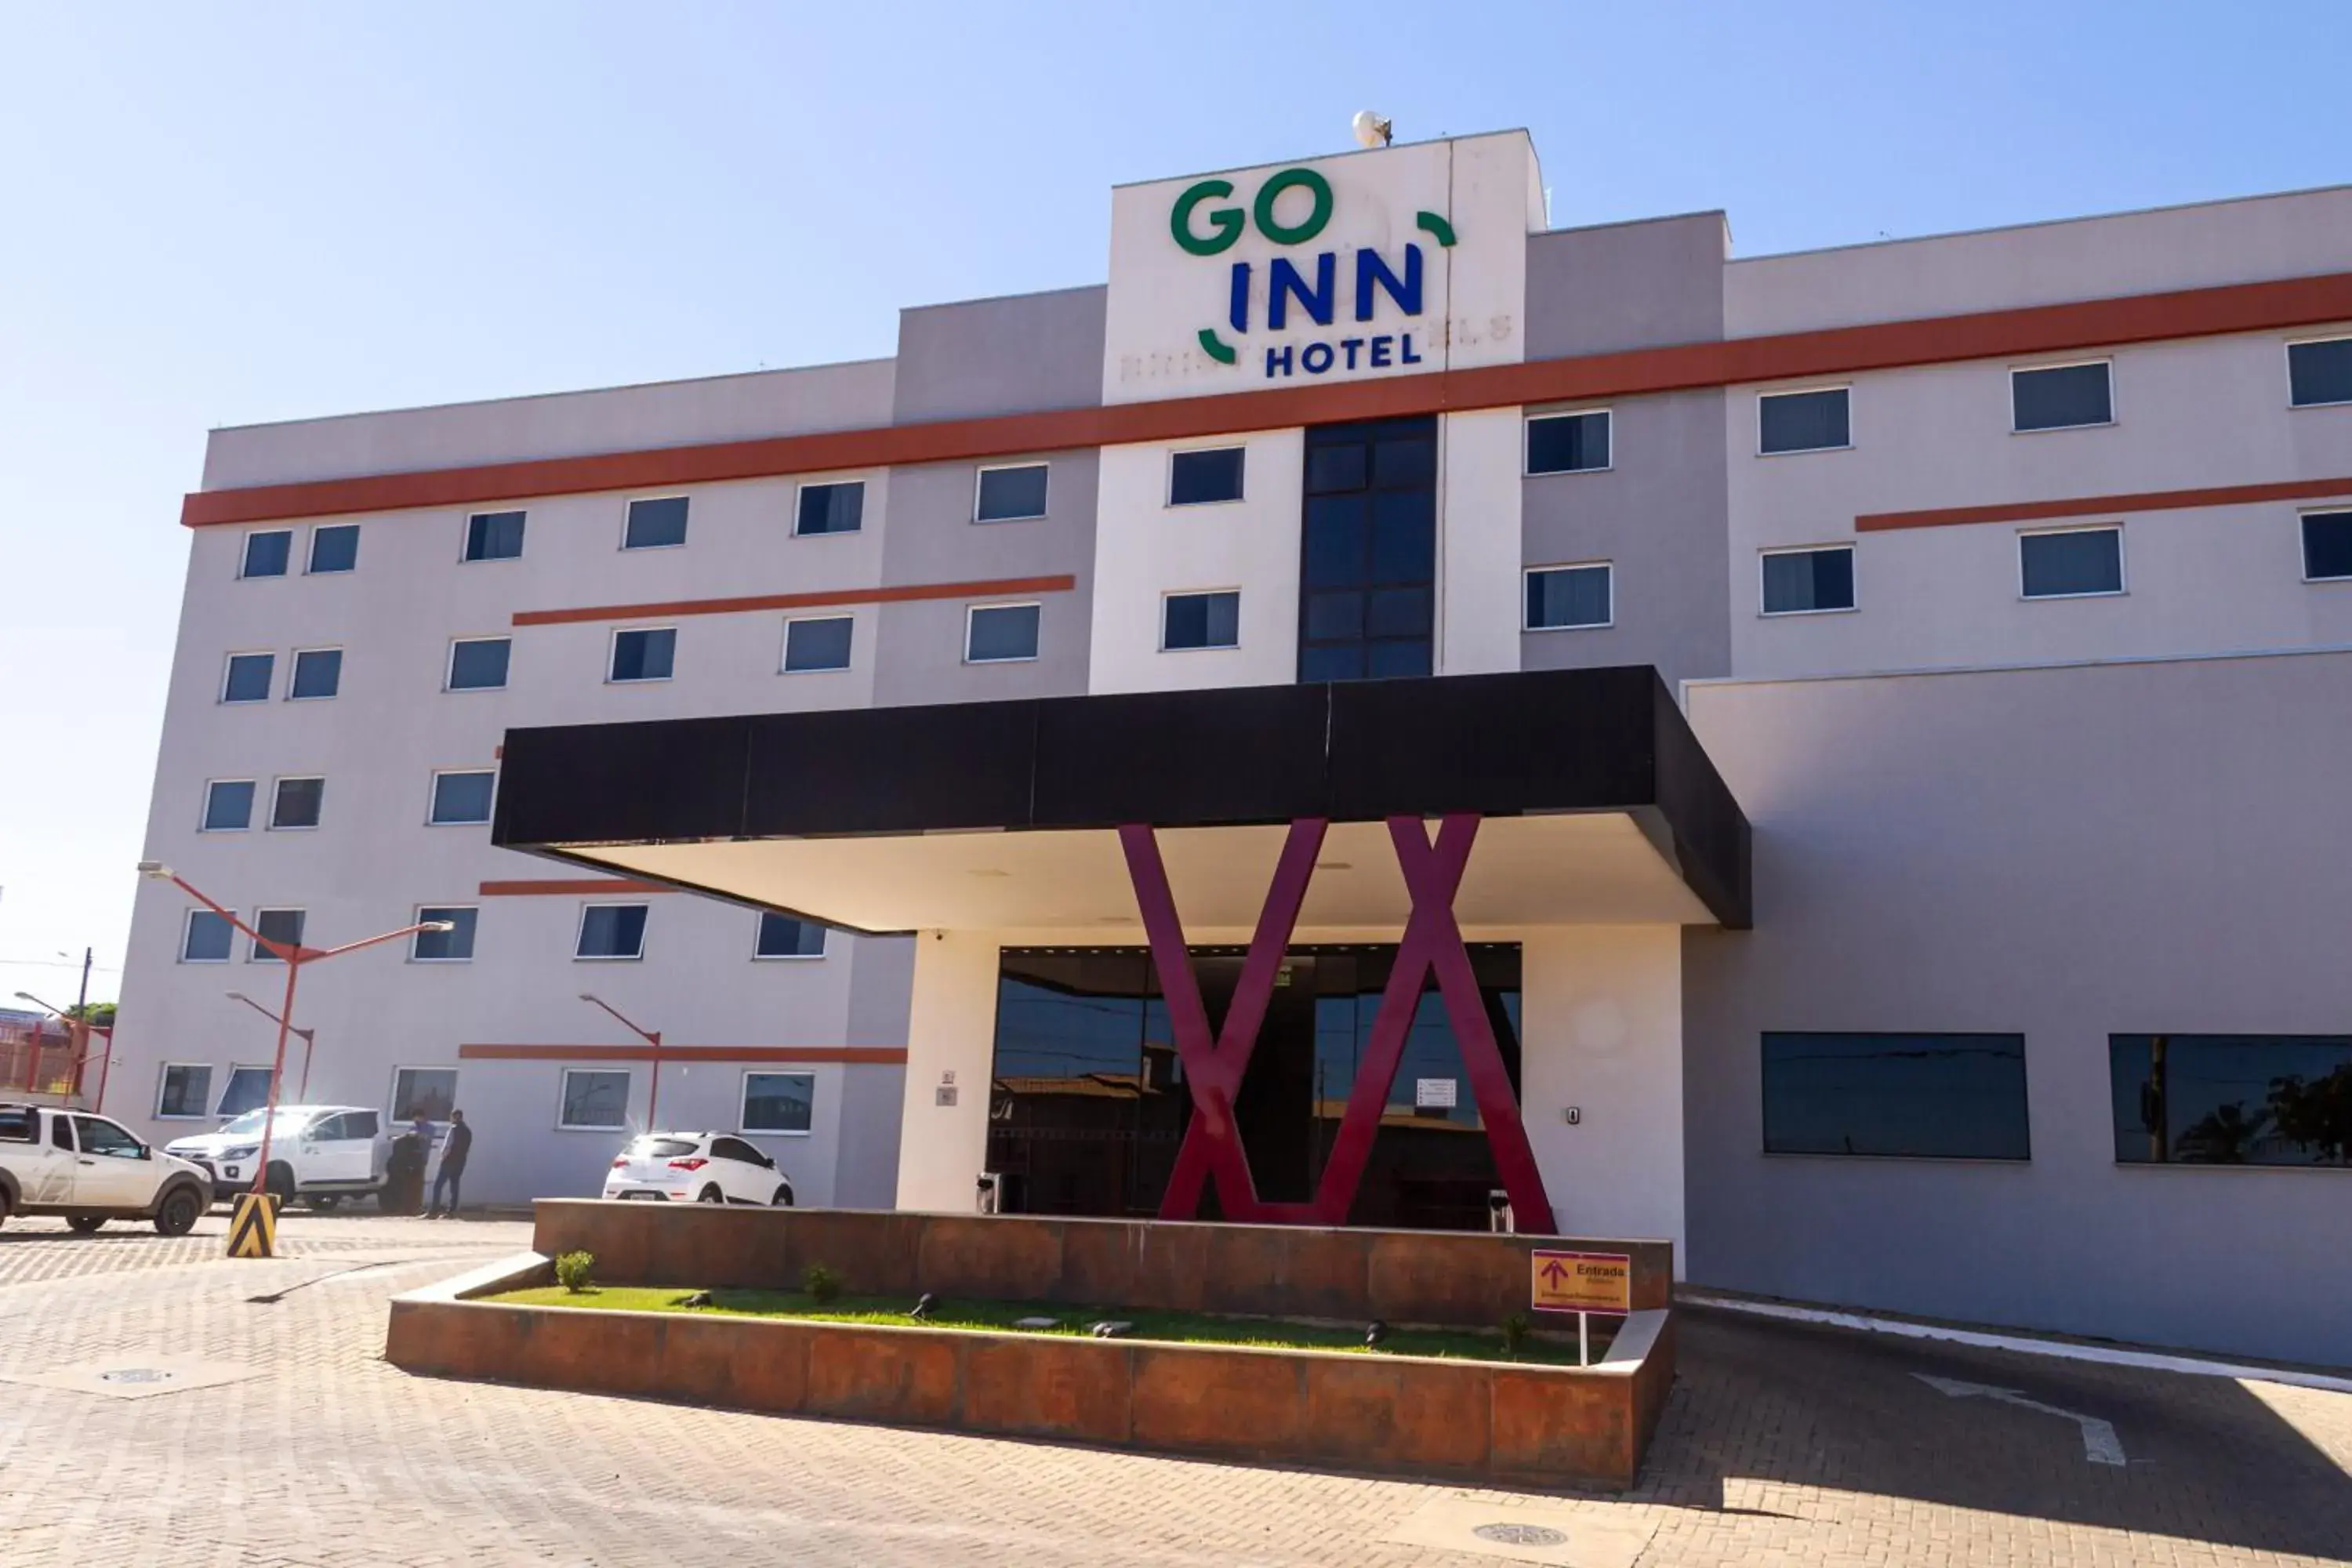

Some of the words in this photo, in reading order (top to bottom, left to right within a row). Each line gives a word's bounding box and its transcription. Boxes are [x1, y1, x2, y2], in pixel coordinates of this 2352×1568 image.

[1171, 168, 1333, 256] GO
[1230, 243, 1423, 333] INN
[1266, 333, 1421, 377] HOTEL
[1577, 1264, 1624, 1276] Entrada
